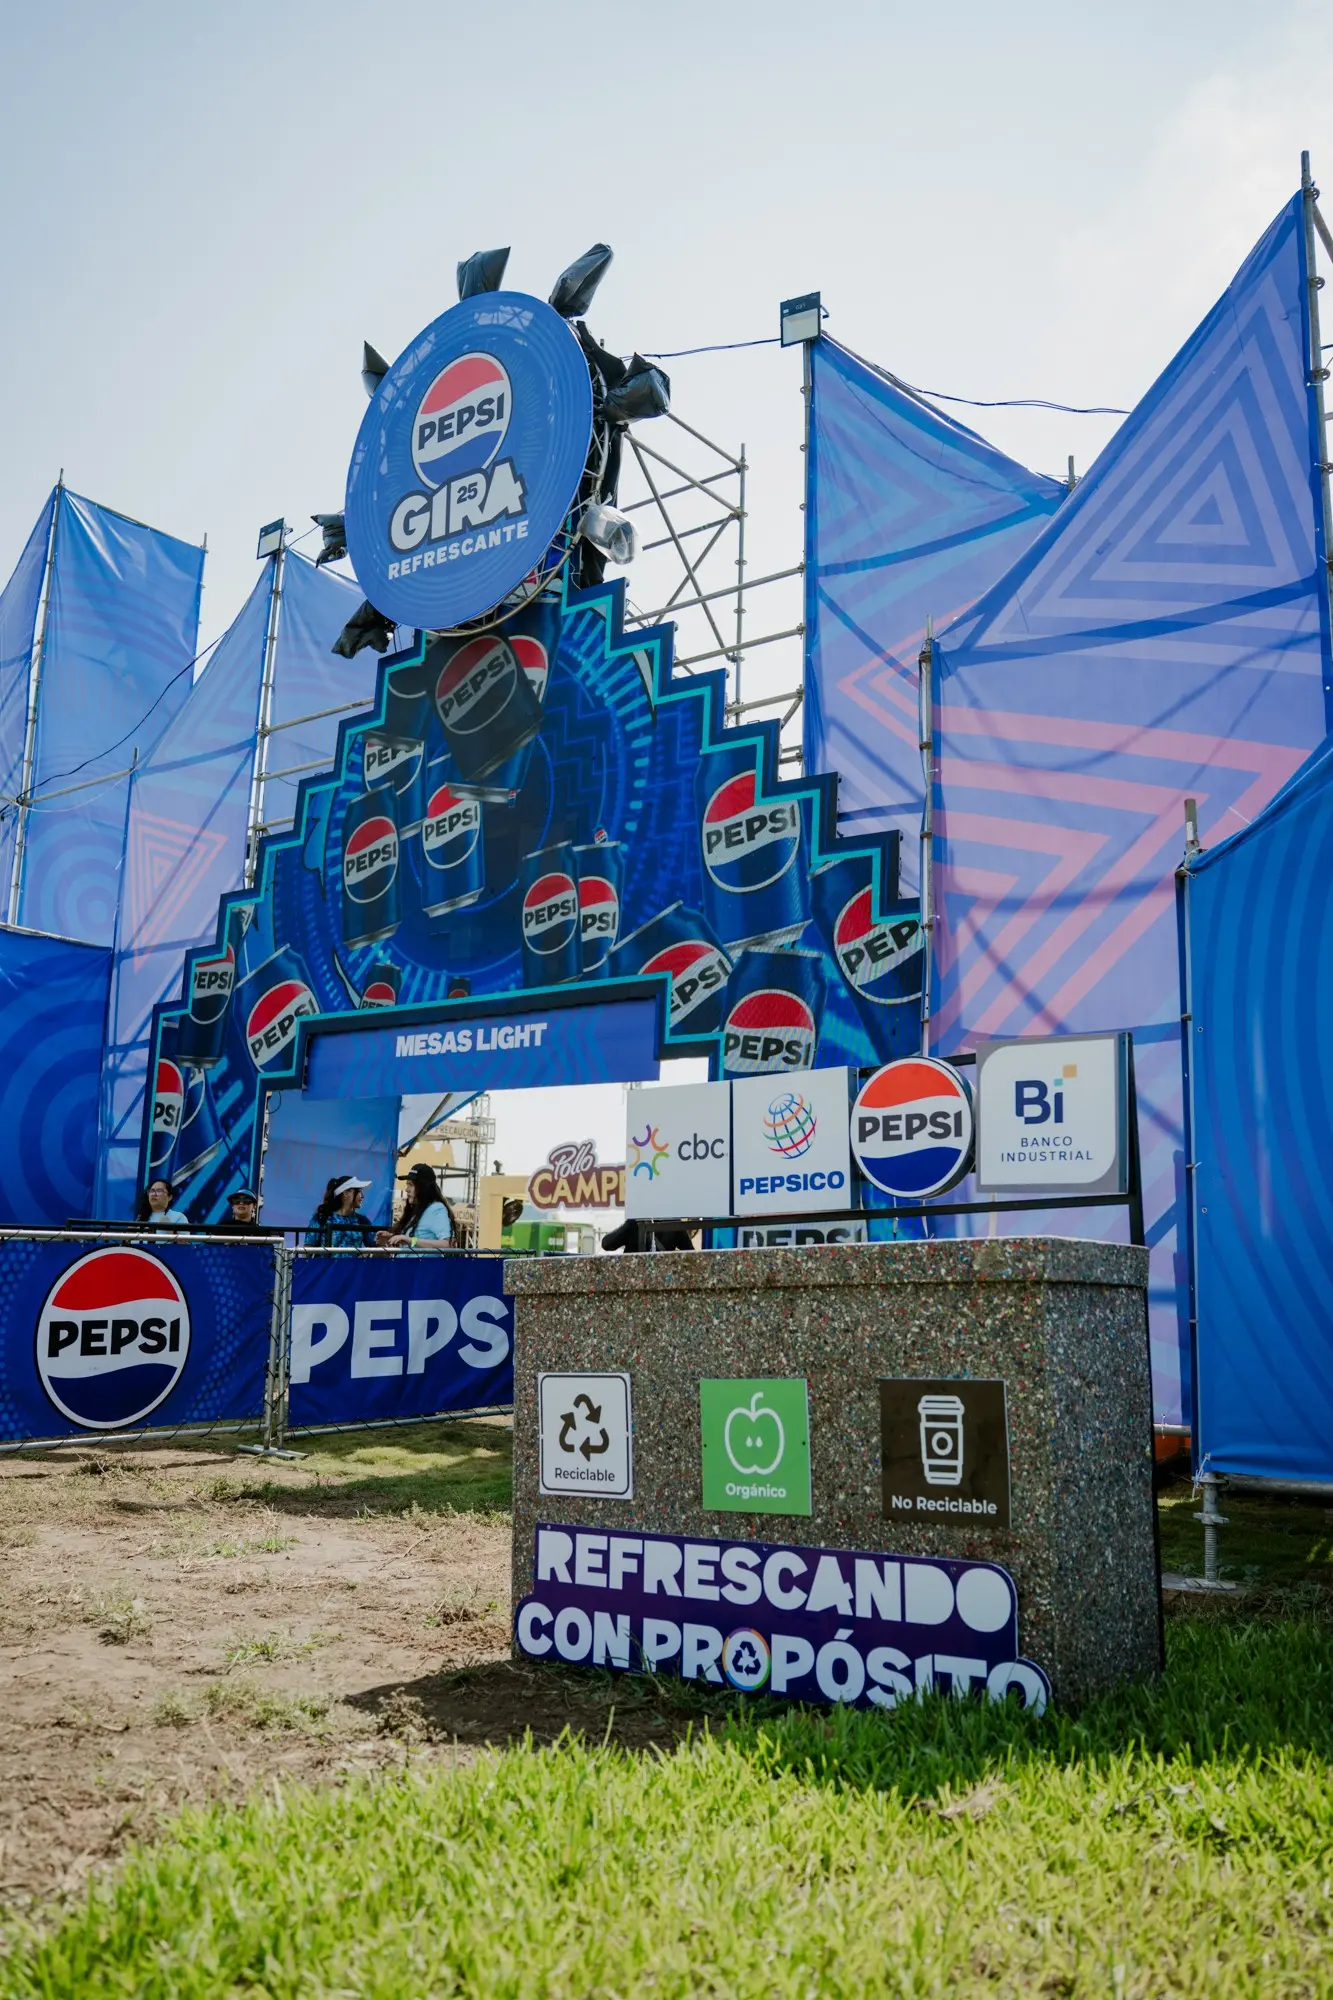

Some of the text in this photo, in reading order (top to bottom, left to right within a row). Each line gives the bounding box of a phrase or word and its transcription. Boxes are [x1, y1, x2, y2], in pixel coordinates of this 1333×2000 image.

[417, 393, 505, 451] PEPSI
[390, 463, 524, 551] GIRA
[456, 481, 478, 504] 25
[388, 520, 529, 580] REFRESCANTE
[440, 648, 512, 719] PEPSI
[424, 803, 479, 842] PEPSI
[704, 804, 797, 855] PEPSI
[345, 842, 397, 877] PEPSI
[524, 897, 577, 929] PEPSI
[250, 997, 317, 1060] PEPSI
[395, 1022, 548, 1058] MESAS LIGHT
[724, 1032, 812, 1067] PEPSI
[1014, 1078, 1064, 1125] Bi
[858, 1110, 963, 1143] PEPSI
[1020, 1136, 1073, 1148] BANCO
[549, 1142, 596, 1181] Pollo
[677, 1132, 725, 1161] cbc
[1001, 1150, 1094, 1162] INDUSTRIAL
[739, 1170, 845, 1195] PEPSICO
[47, 1317, 182, 1358] PEPSI
[290, 1295, 510, 1385] PEPS
[554, 1466, 615, 1483] Reciclable
[725, 1481, 787, 1500] Orgánico
[891, 1494, 998, 1516] No Reciclable
[538, 1529, 1012, 1633] REFRESCANDO
[517, 1601, 1048, 1718] CON PROPÓSITO
